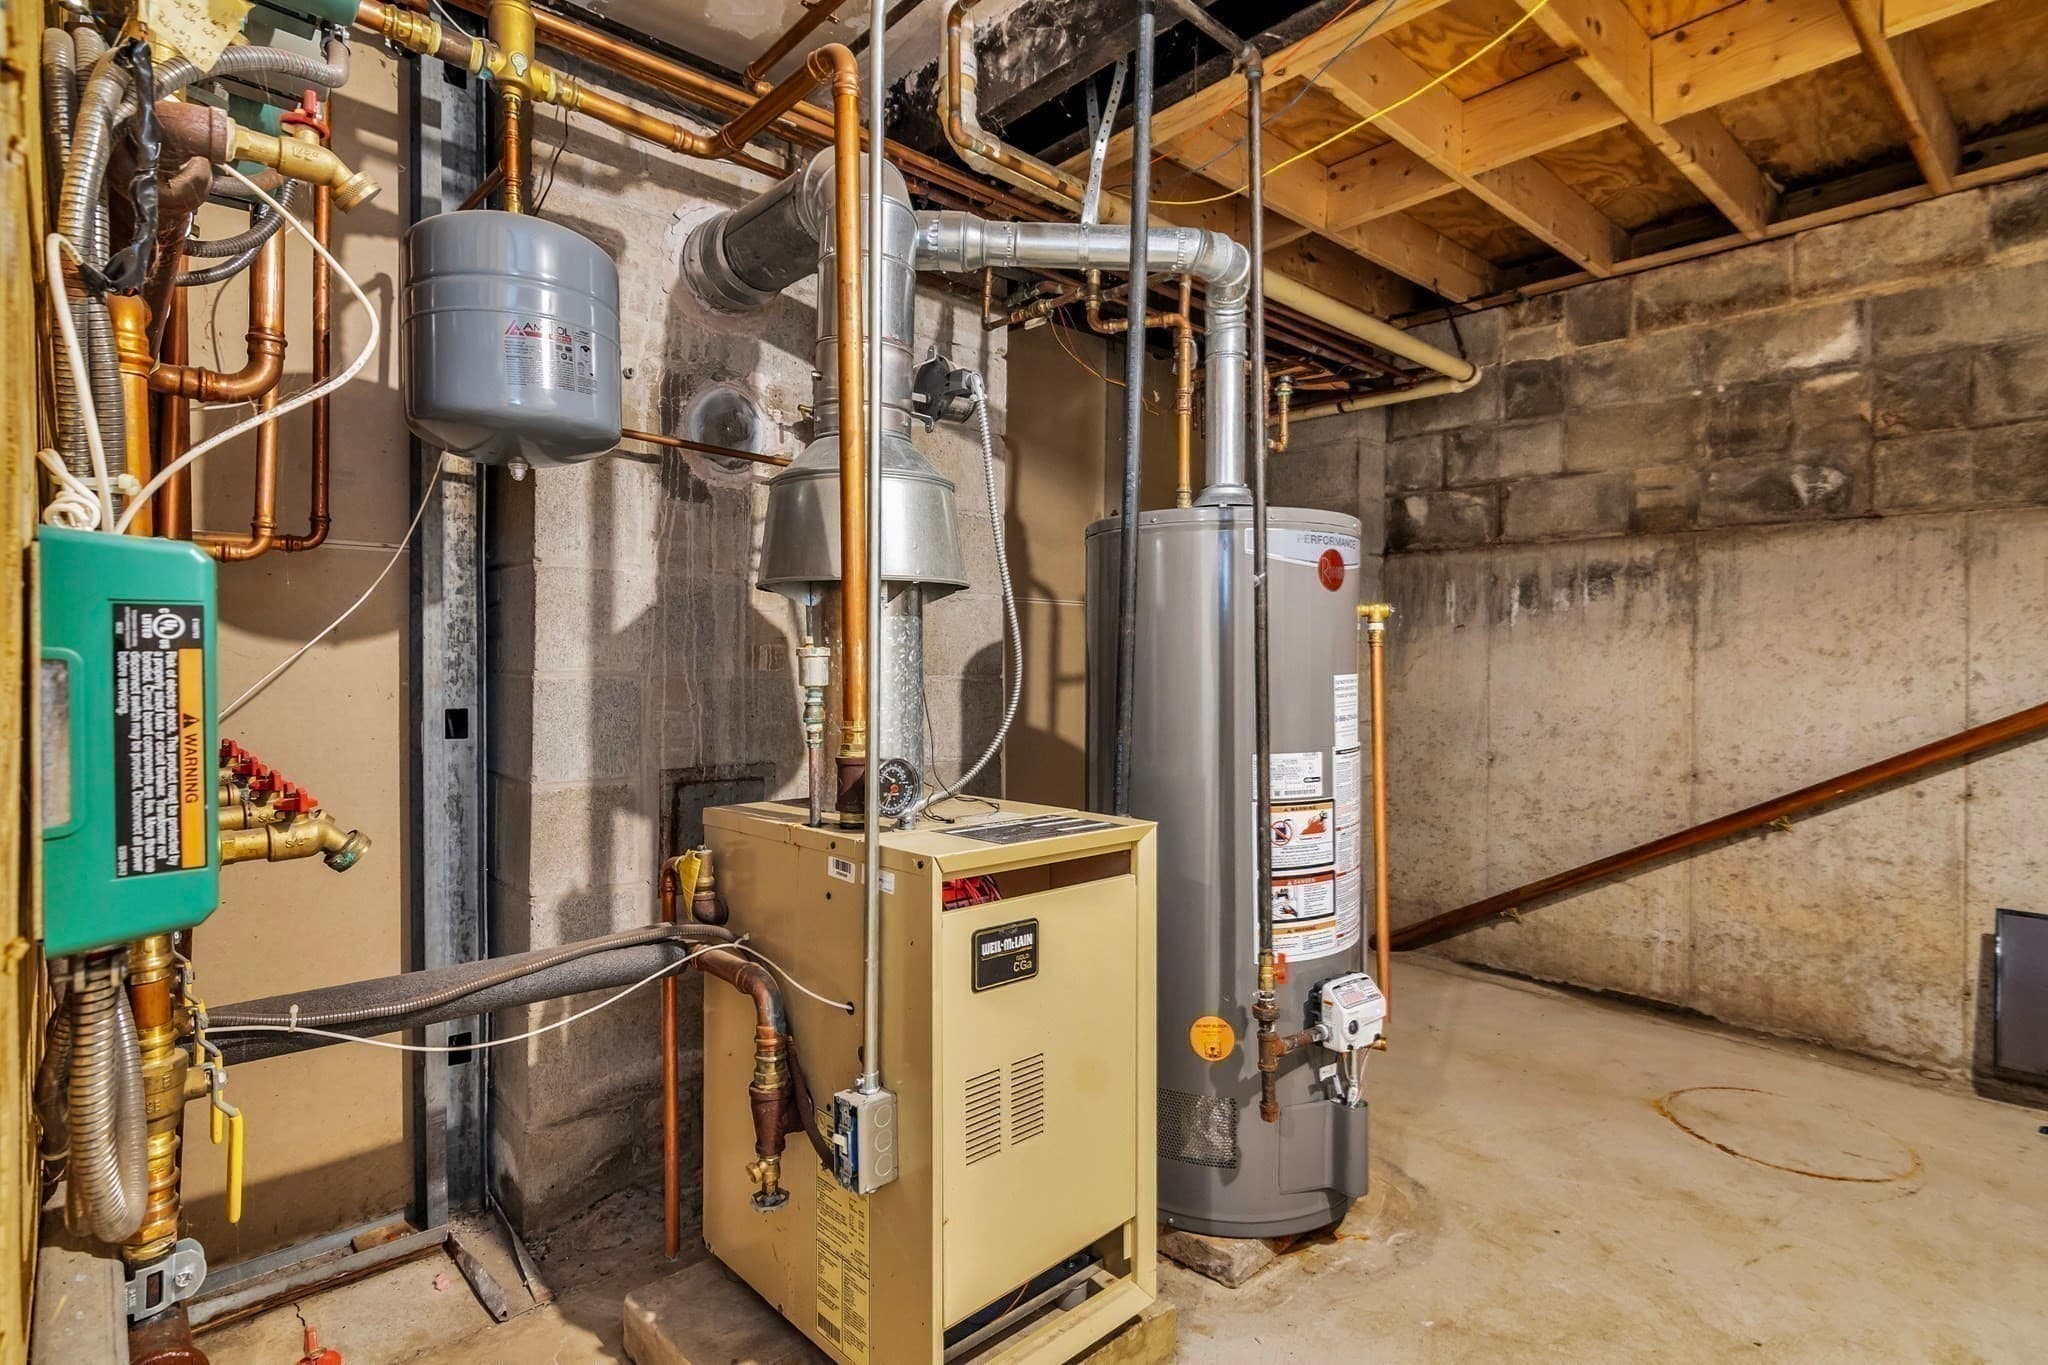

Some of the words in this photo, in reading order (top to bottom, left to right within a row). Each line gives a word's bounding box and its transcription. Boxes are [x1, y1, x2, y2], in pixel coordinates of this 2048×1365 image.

[117, 651, 128, 677] before
[166, 652, 177, 668] Risk
[131, 652, 141, 694] disconnect
[153, 658, 165, 689] properly
[143, 685, 153, 710] Circuit
[155, 692, 165, 711] sized
[167, 679, 177, 707] electric
[131, 696, 141, 721] switch
[128, 723, 140, 740] may
[143, 712, 153, 734] board
[155, 714, 165, 730] fuse
[131, 741, 142, 751] be
[155, 732, 164, 740] or
[168, 736, 178, 752] This
[144, 736, 154, 784] components
[156, 741, 165, 765] circuit
[167, 754, 178, 783] product
[185, 734, 198, 803] WARNING
[144, 786, 153, 798] are
[168, 785, 179, 804] must
[132, 791, 143, 834] Disconnect
[168, 806, 179, 816] be
[145, 817, 156, 837] More
[156, 799, 166, 844] Transformer
[167, 818, 180, 854] protected
[145, 838, 156, 856] than
[156, 846, 167, 859] not
[131, 847, 143, 871] power
[145, 858, 155, 872] one
[167, 856, 180, 865] by
[1013, 960, 1033, 972] CGa
